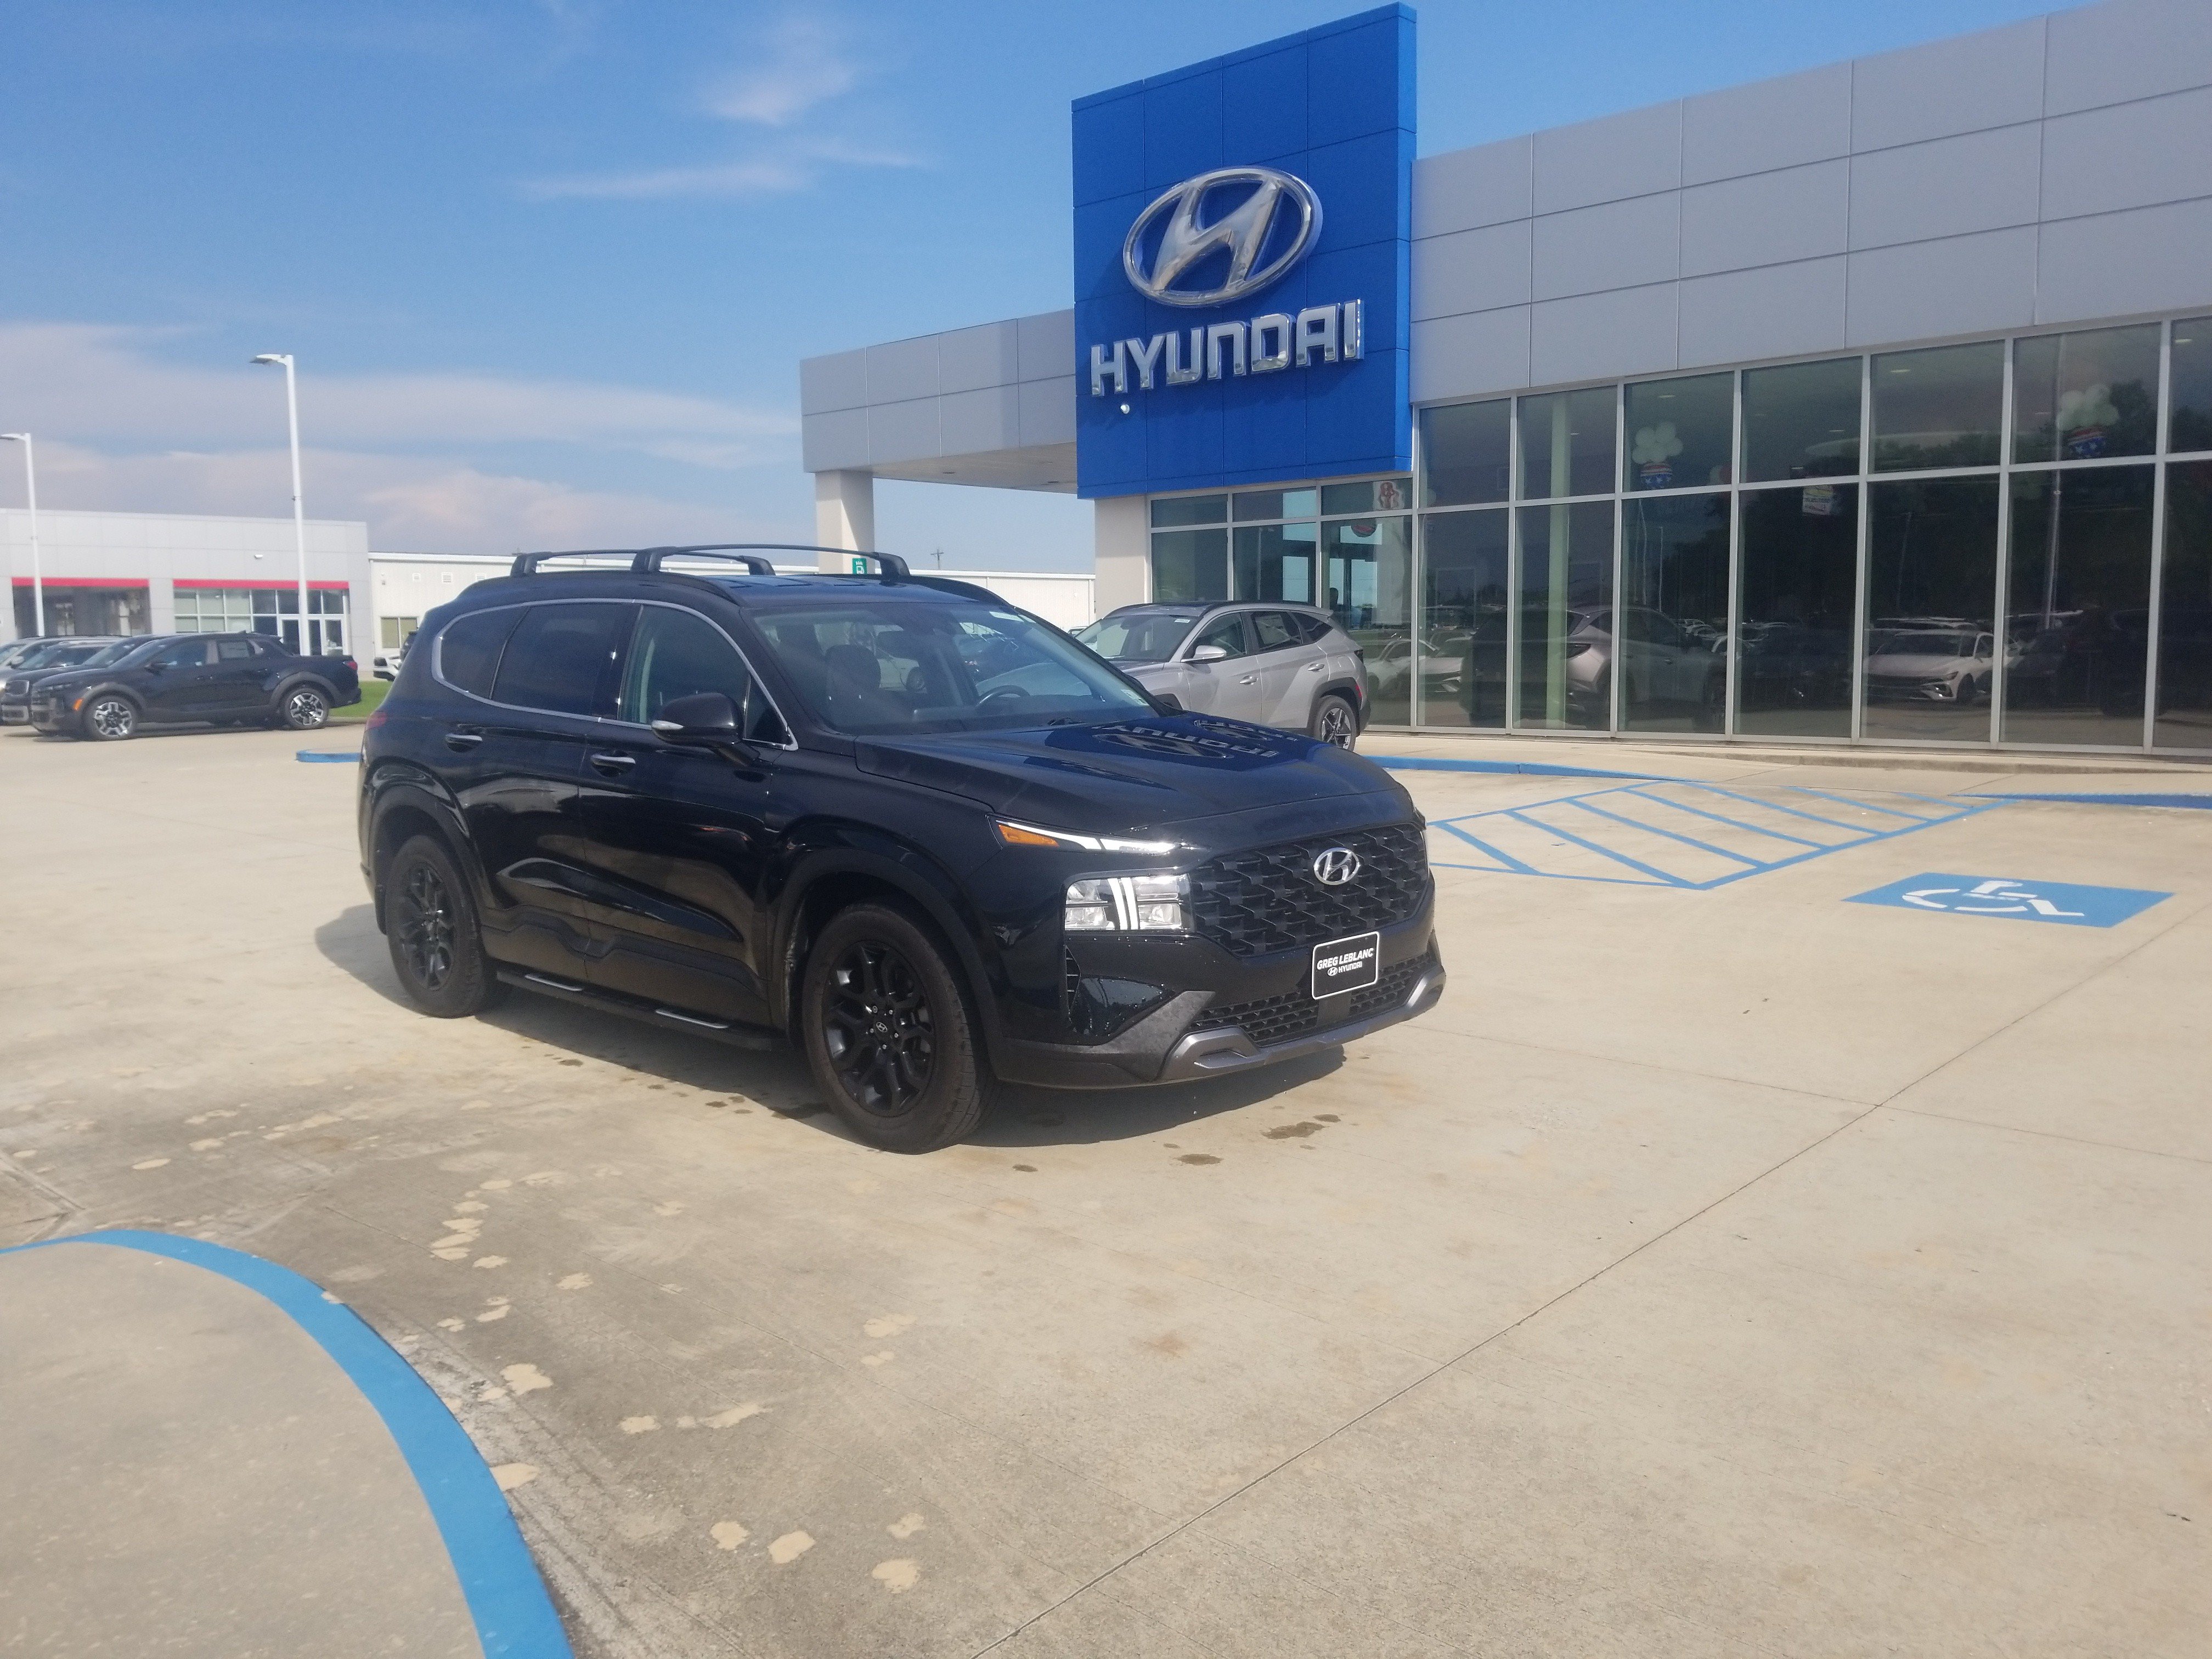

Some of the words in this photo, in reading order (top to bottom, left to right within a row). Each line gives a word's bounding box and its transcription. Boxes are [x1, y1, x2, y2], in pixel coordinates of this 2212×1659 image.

[1091, 299, 1365, 396] HYUNDAI
[1317, 956, 1339, 970] GREG
[1339, 947, 1374, 964] LEBLANC
[1338, 961, 1362, 973] HYUNDAI
